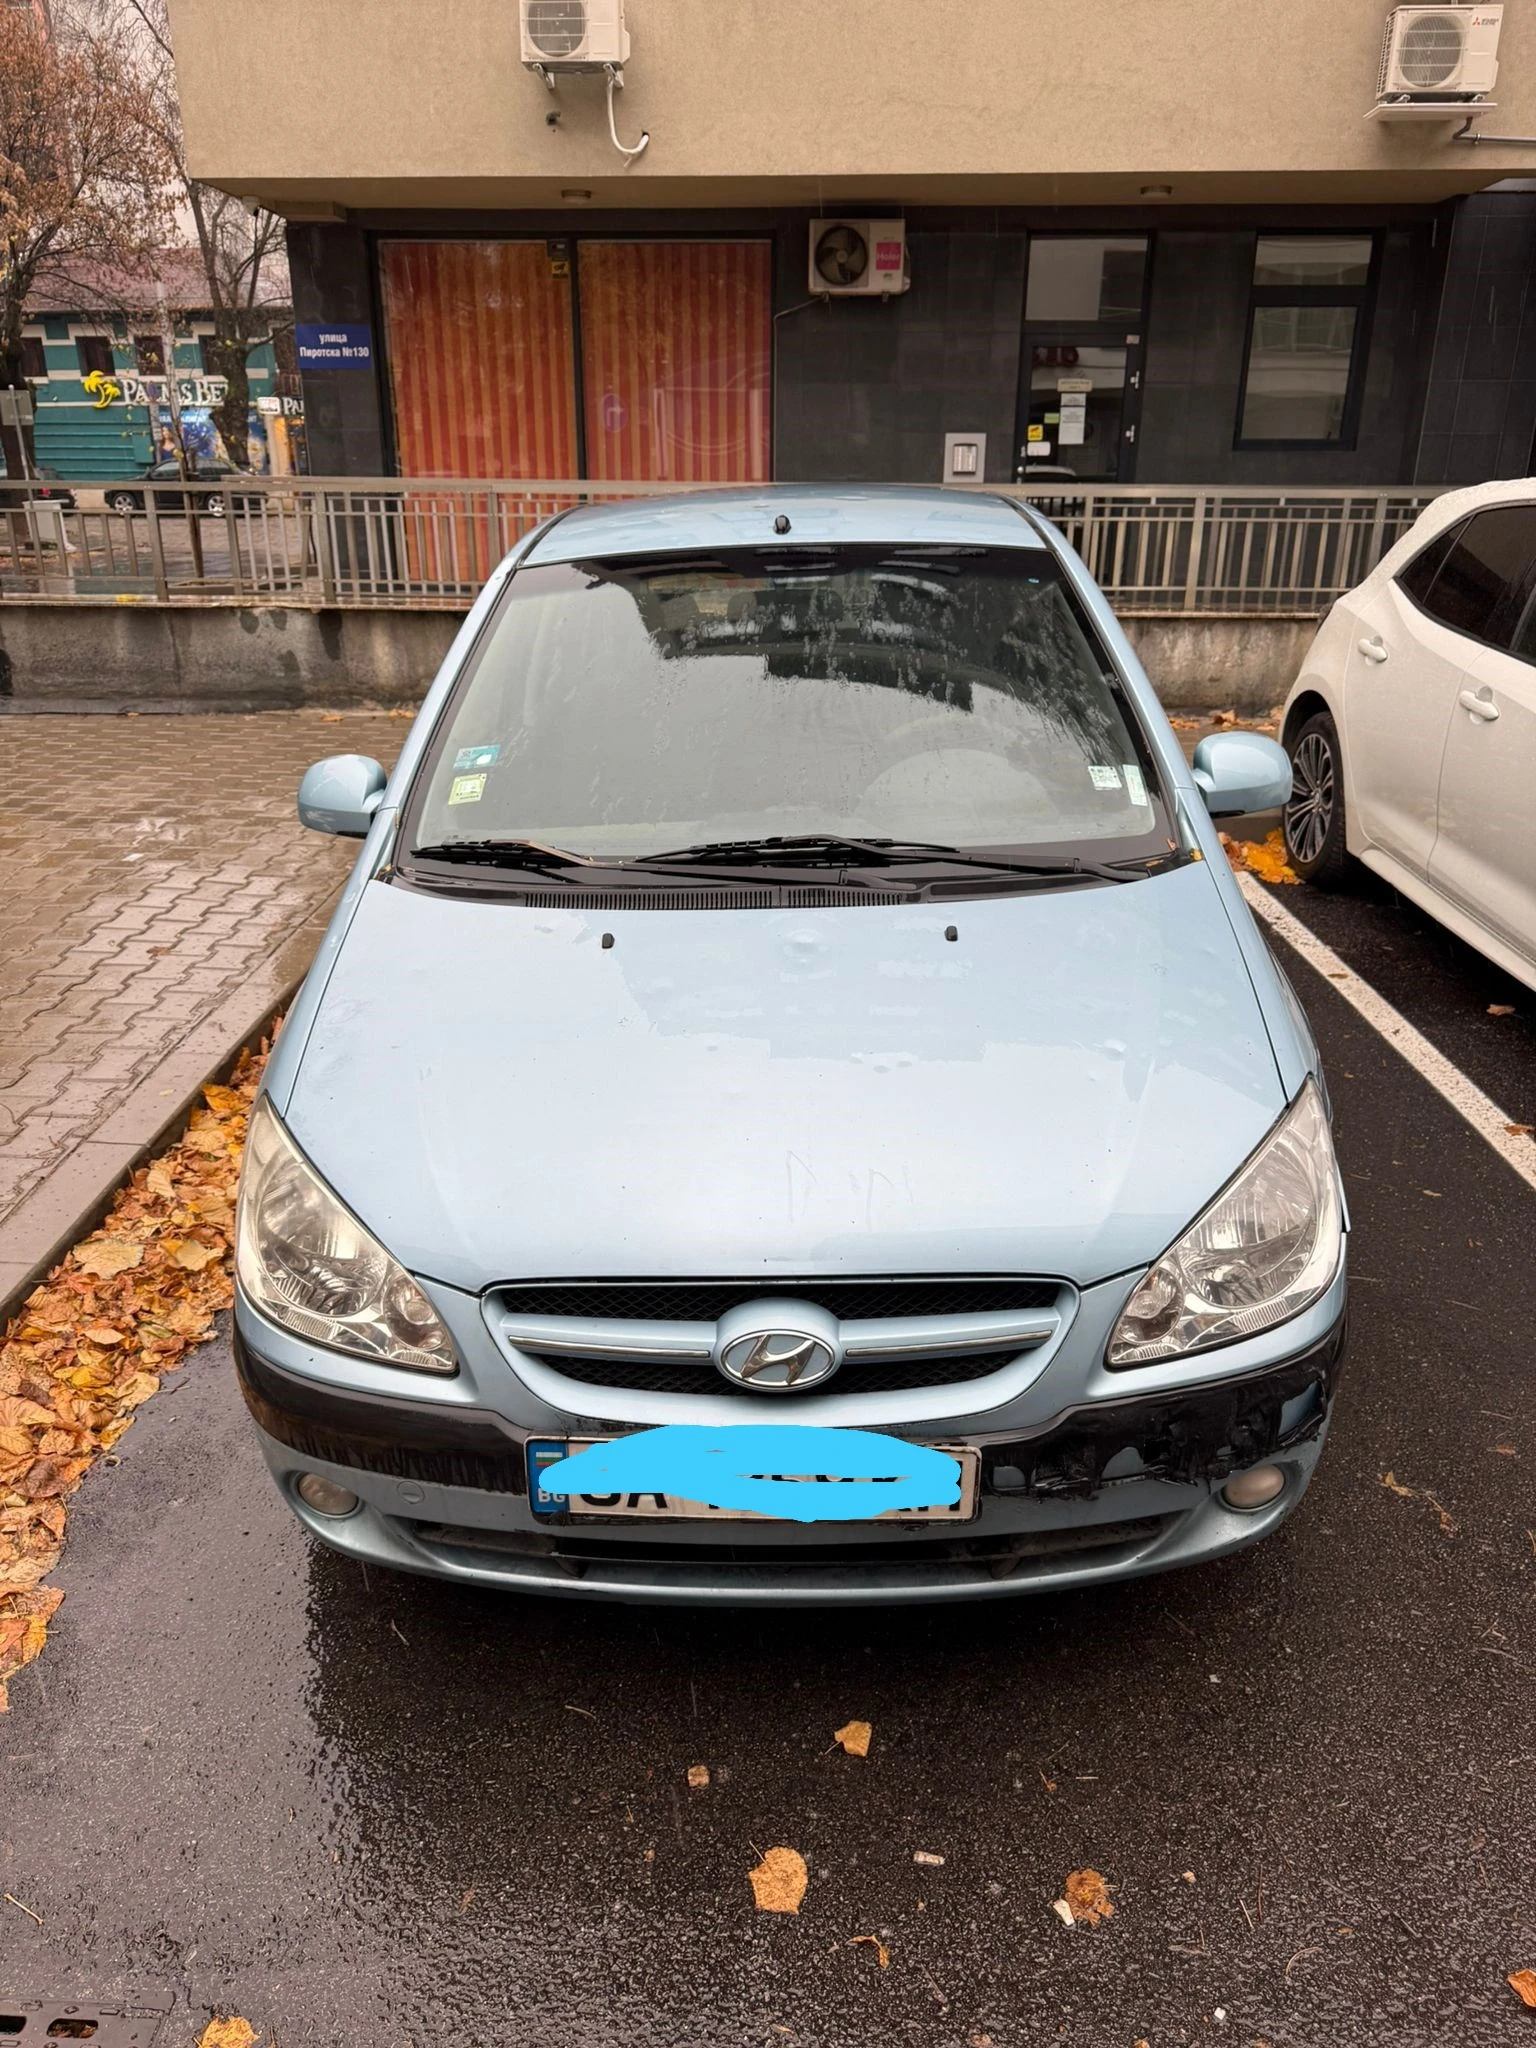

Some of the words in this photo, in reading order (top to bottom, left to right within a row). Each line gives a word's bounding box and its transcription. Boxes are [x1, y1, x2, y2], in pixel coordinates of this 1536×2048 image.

[318, 333, 348, 345] улица
[299, 346, 341, 359] Пиротска
[342, 346, 370, 358] №130
